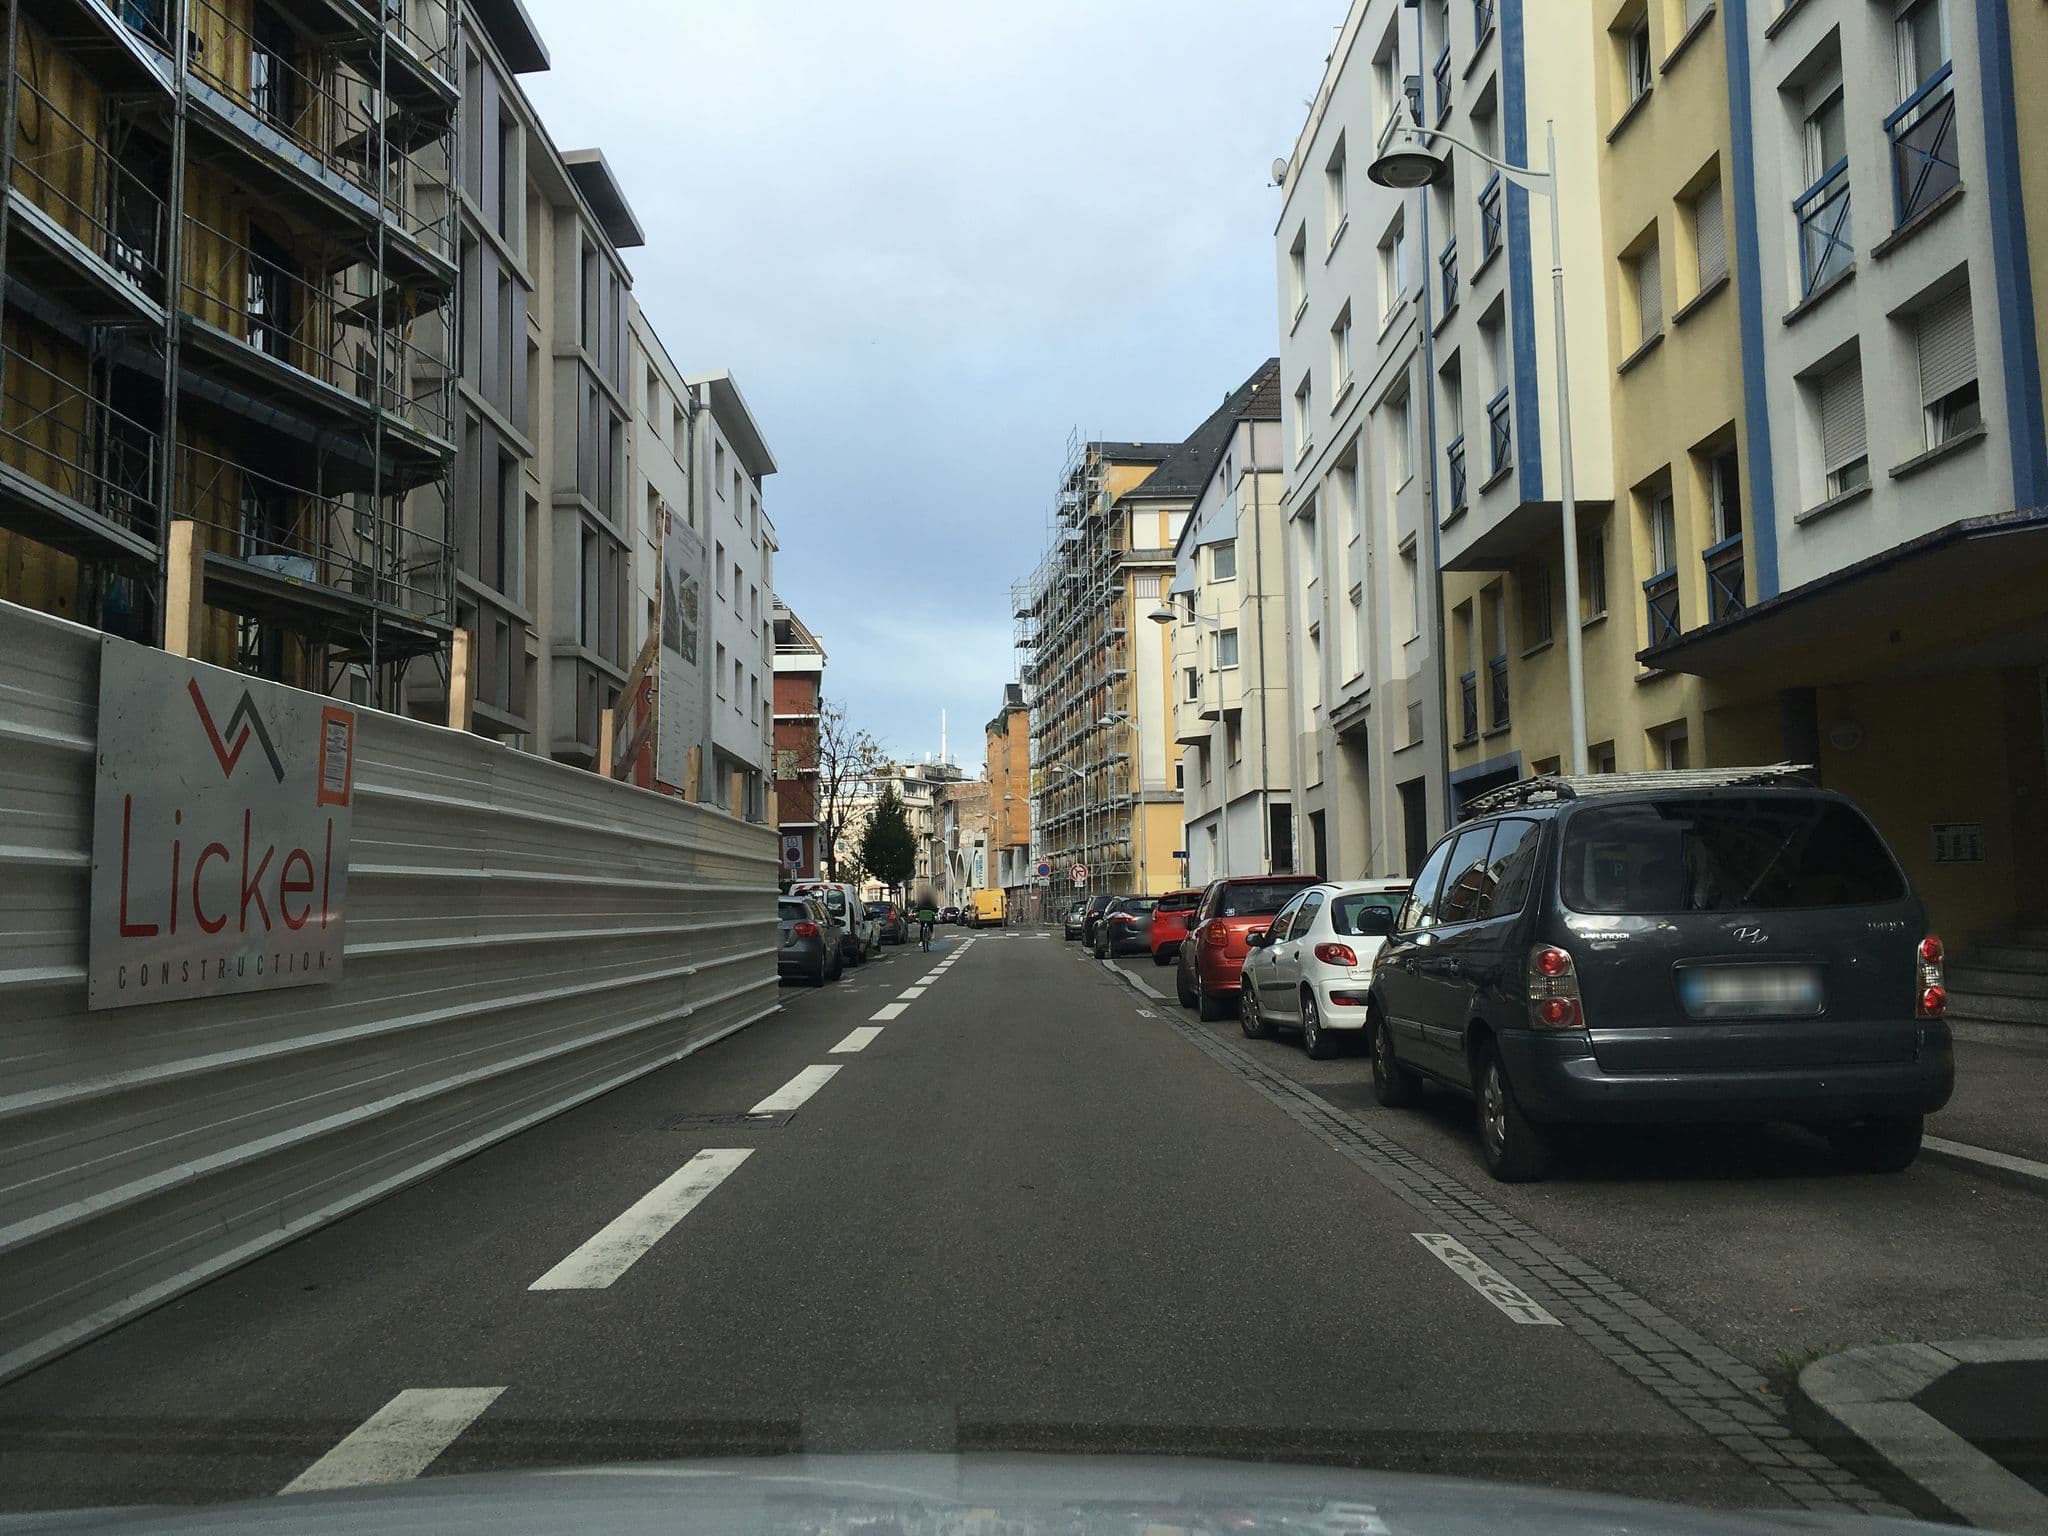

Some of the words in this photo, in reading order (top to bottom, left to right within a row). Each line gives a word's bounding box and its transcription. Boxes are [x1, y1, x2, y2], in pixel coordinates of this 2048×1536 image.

[120, 794, 333, 937] Lickel
[118, 952, 326, 989] CONSTRUCTION
[1421, 1234, 1541, 1321] PAYANT
